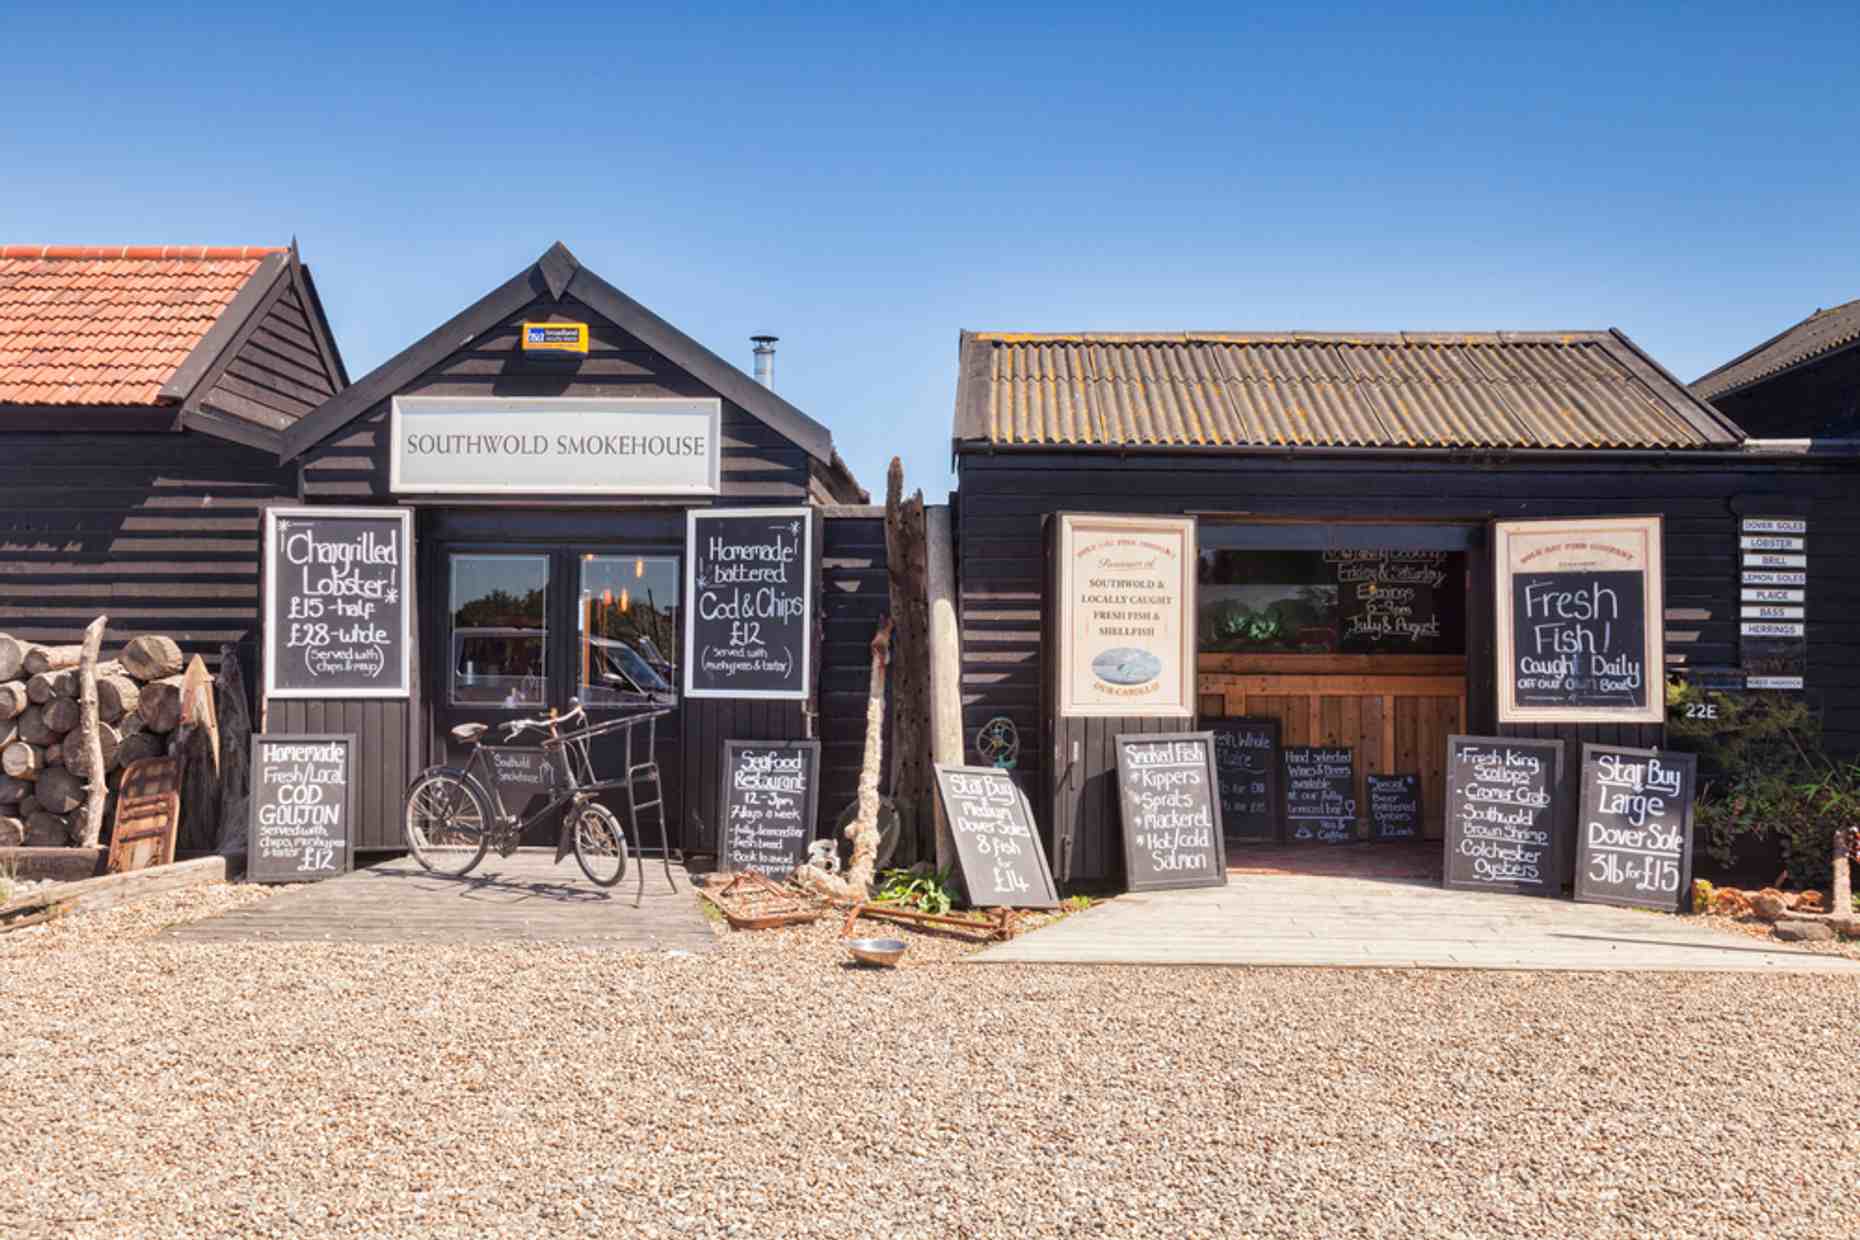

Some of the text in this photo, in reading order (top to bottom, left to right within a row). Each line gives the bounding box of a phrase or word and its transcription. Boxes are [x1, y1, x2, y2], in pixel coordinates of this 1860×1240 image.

[407, 434, 705, 457] SOUTHWOLD SMOKEHOUSE
[1776, 522, 1804, 530] SOLES
[287, 529, 398, 577] Chargrilled
[709, 535, 793, 561] Homemade
[1750, 539, 1793, 548] LOBSTER
[1762, 556, 1787, 565] BRILL
[715, 562, 787, 583] battered
[1776, 574, 1805, 582] SOLES
[1089, 579, 1155, 589] SOUTHWOLD
[700, 587, 804, 625] Cod & Chips
[1081, 595, 1173, 605] LOCALLY CAUGHT
[1525, 579, 1618, 620] Fresh
[1756, 591, 1789, 600] PLAICE
[288, 596, 324, 619] £15
[1094, 611, 1126, 620] FRESH
[1127, 611, 1151, 620] FISH
[1760, 608, 1785, 617] BASS
[729, 621, 766, 646] £12
[1099, 627, 1155, 636] SHELLFISH
[1748, 625, 1796, 634] HERRINGS
[1592, 654, 1640, 688] Daily
[1686, 703, 1718, 719] 22E
[263, 743, 345, 763] Homemade
[741, 750, 801, 771] Seafood
[1175, 741, 1203, 762] Fish
[1463, 747, 1540, 774] Fresh King
[735, 771, 806, 792] Restaurant
[1142, 769, 1201, 791] Kippers
[1473, 764, 1530, 786] Scallops
[1597, 755, 1681, 797] Star Buy
[278, 784, 323, 805] COD
[950, 774, 1015, 806] Star Buy
[1516, 786, 1551, 806] Crab
[1142, 790, 1193, 812] Sprats
[1598, 785, 1665, 826] Large
[259, 804, 341, 825] GOUJON
[1463, 803, 1533, 825] Southwold
[958, 817, 995, 834] Dover
[1463, 822, 1547, 843] Brown Shrimp
[976, 834, 1021, 857] 8 fish
[1588, 822, 1683, 852] Dover Sole
[297, 847, 336, 872] £12
[1152, 851, 1207, 871] Salmon
[1460, 839, 1541, 864] Colchester
[993, 867, 1030, 893] £14
[1474, 858, 1539, 881] Oysters
[1588, 853, 1679, 892] 3lb for £15
